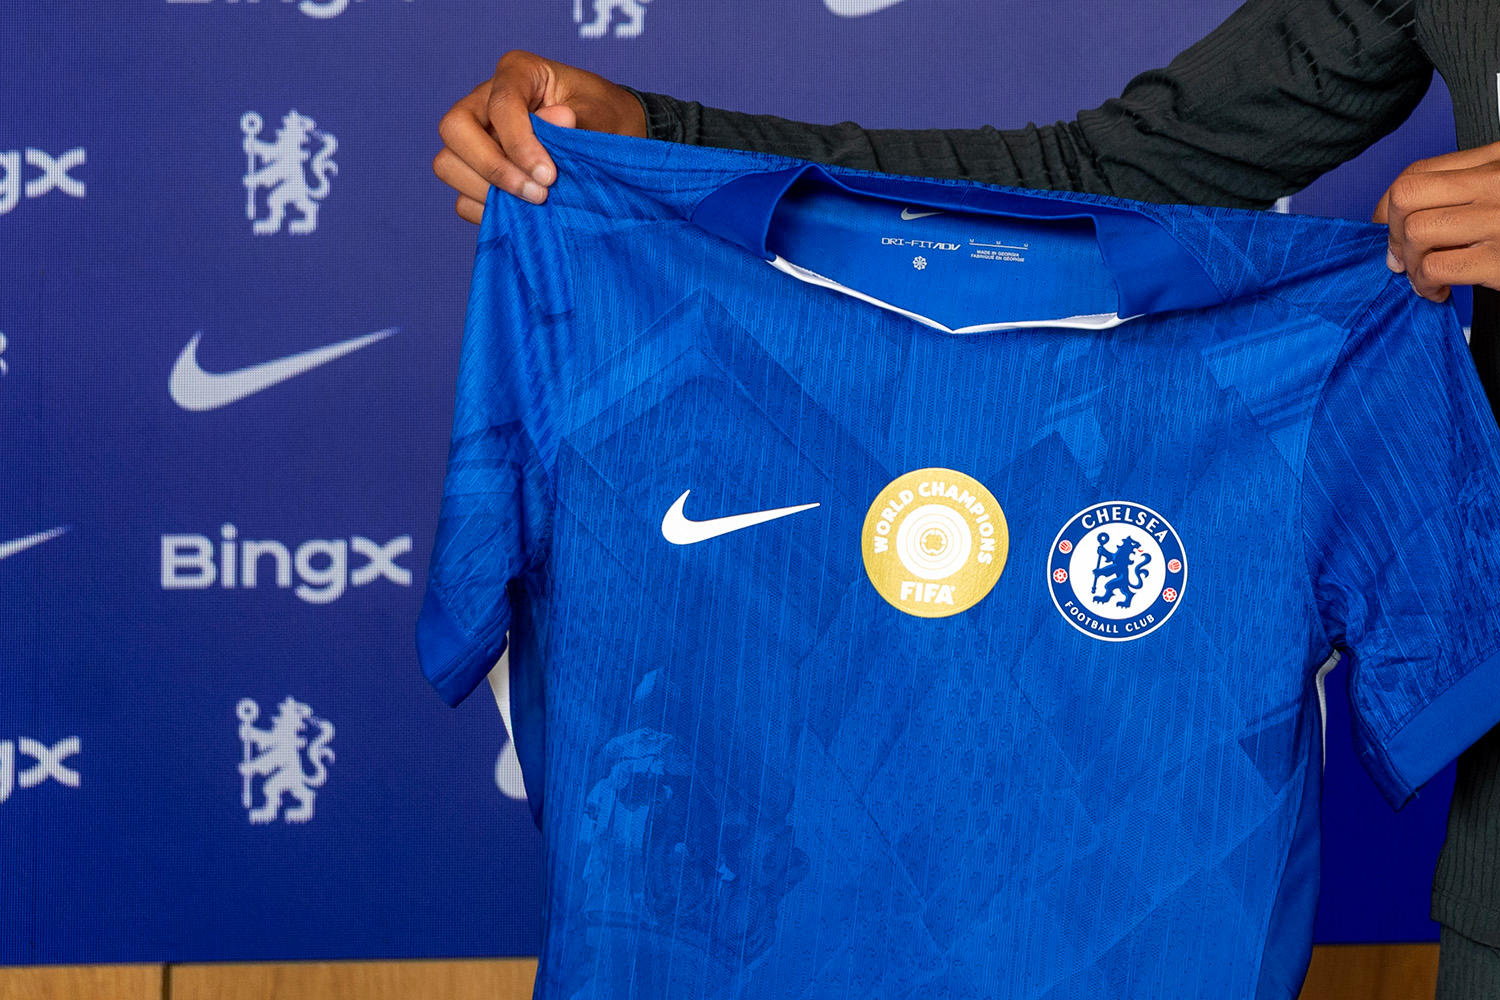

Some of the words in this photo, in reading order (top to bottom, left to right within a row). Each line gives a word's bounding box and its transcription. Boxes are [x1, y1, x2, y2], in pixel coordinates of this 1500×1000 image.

[873, 489, 914, 554] WORLD
[918, 481, 996, 565] CHAMPIONS
[1081, 507, 1168, 543] CHELSEA
[900, 581, 956, 605] FIFA
[1064, 600, 1119, 633] FOOTBALL
[1125, 614, 1155, 632] CLUB
